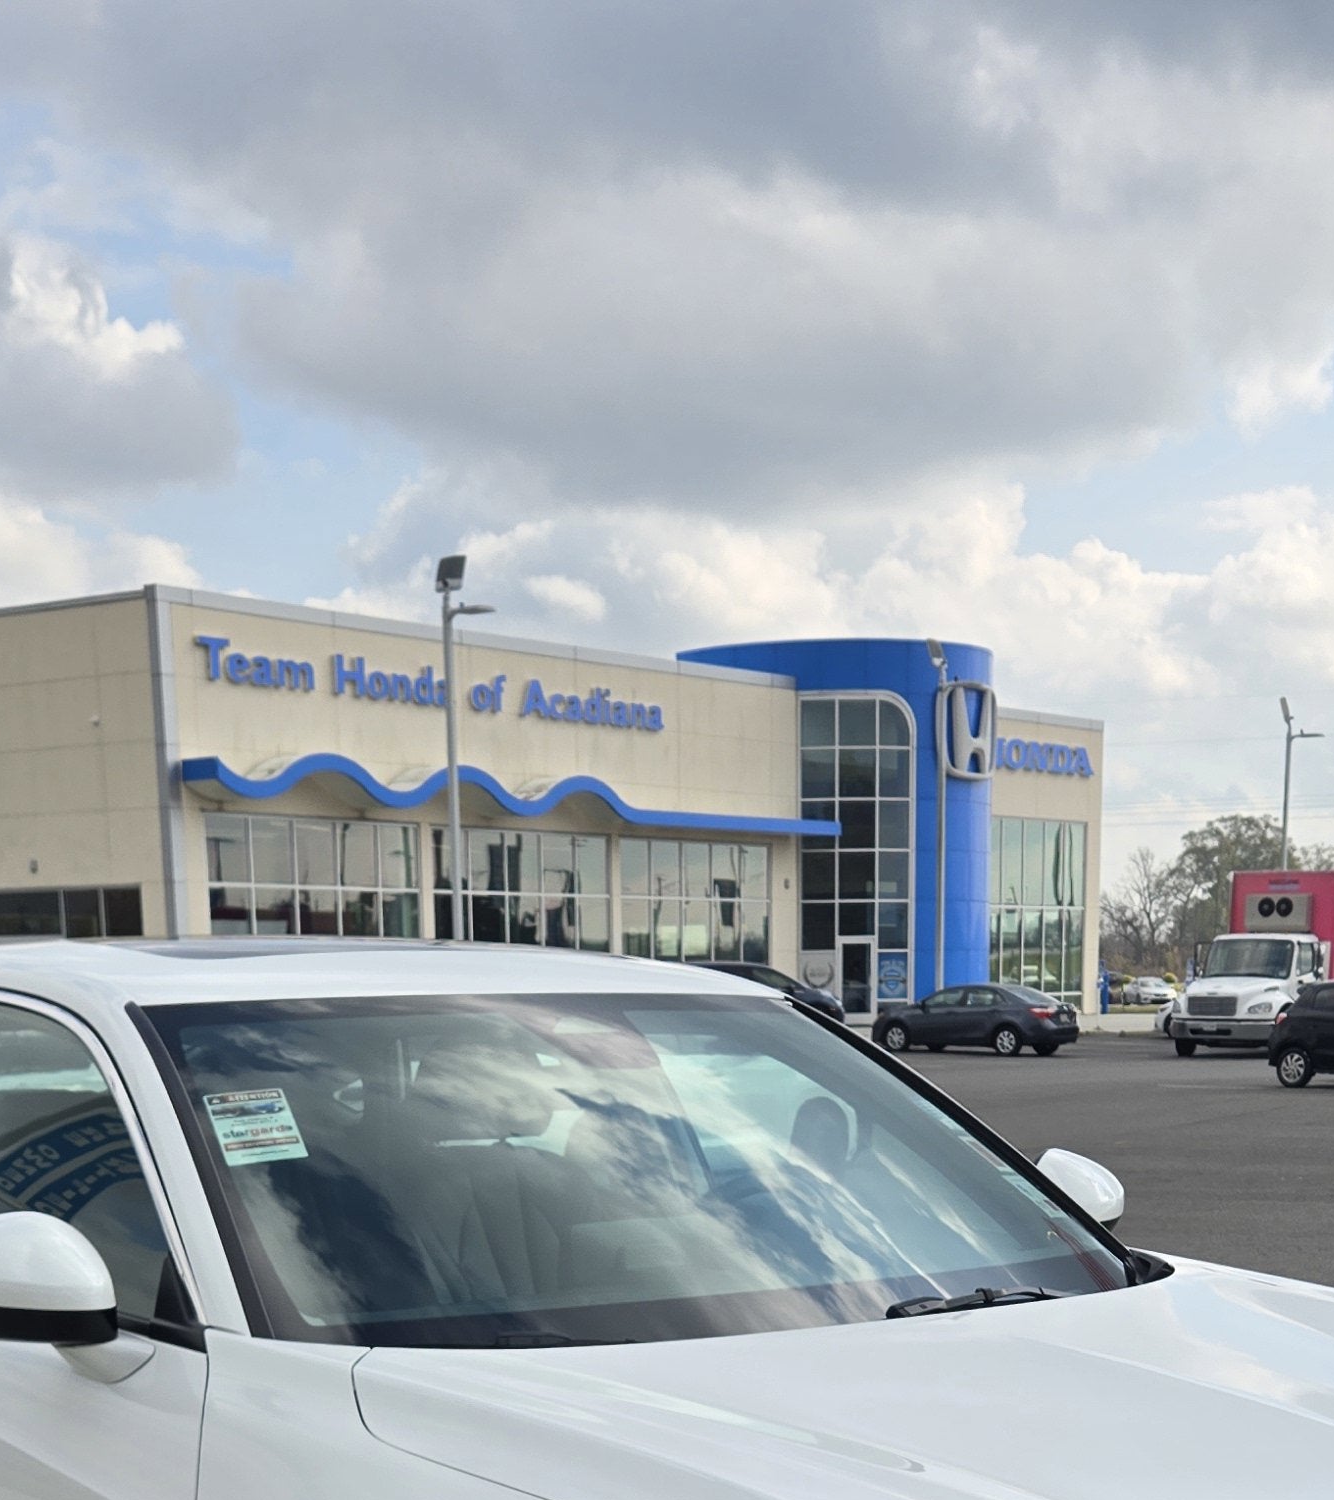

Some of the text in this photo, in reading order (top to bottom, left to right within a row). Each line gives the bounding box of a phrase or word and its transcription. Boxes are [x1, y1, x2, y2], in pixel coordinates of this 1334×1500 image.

[194, 635, 315, 692] Team
[470, 674, 507, 714] of
[519, 678, 665, 732] Acadiana
